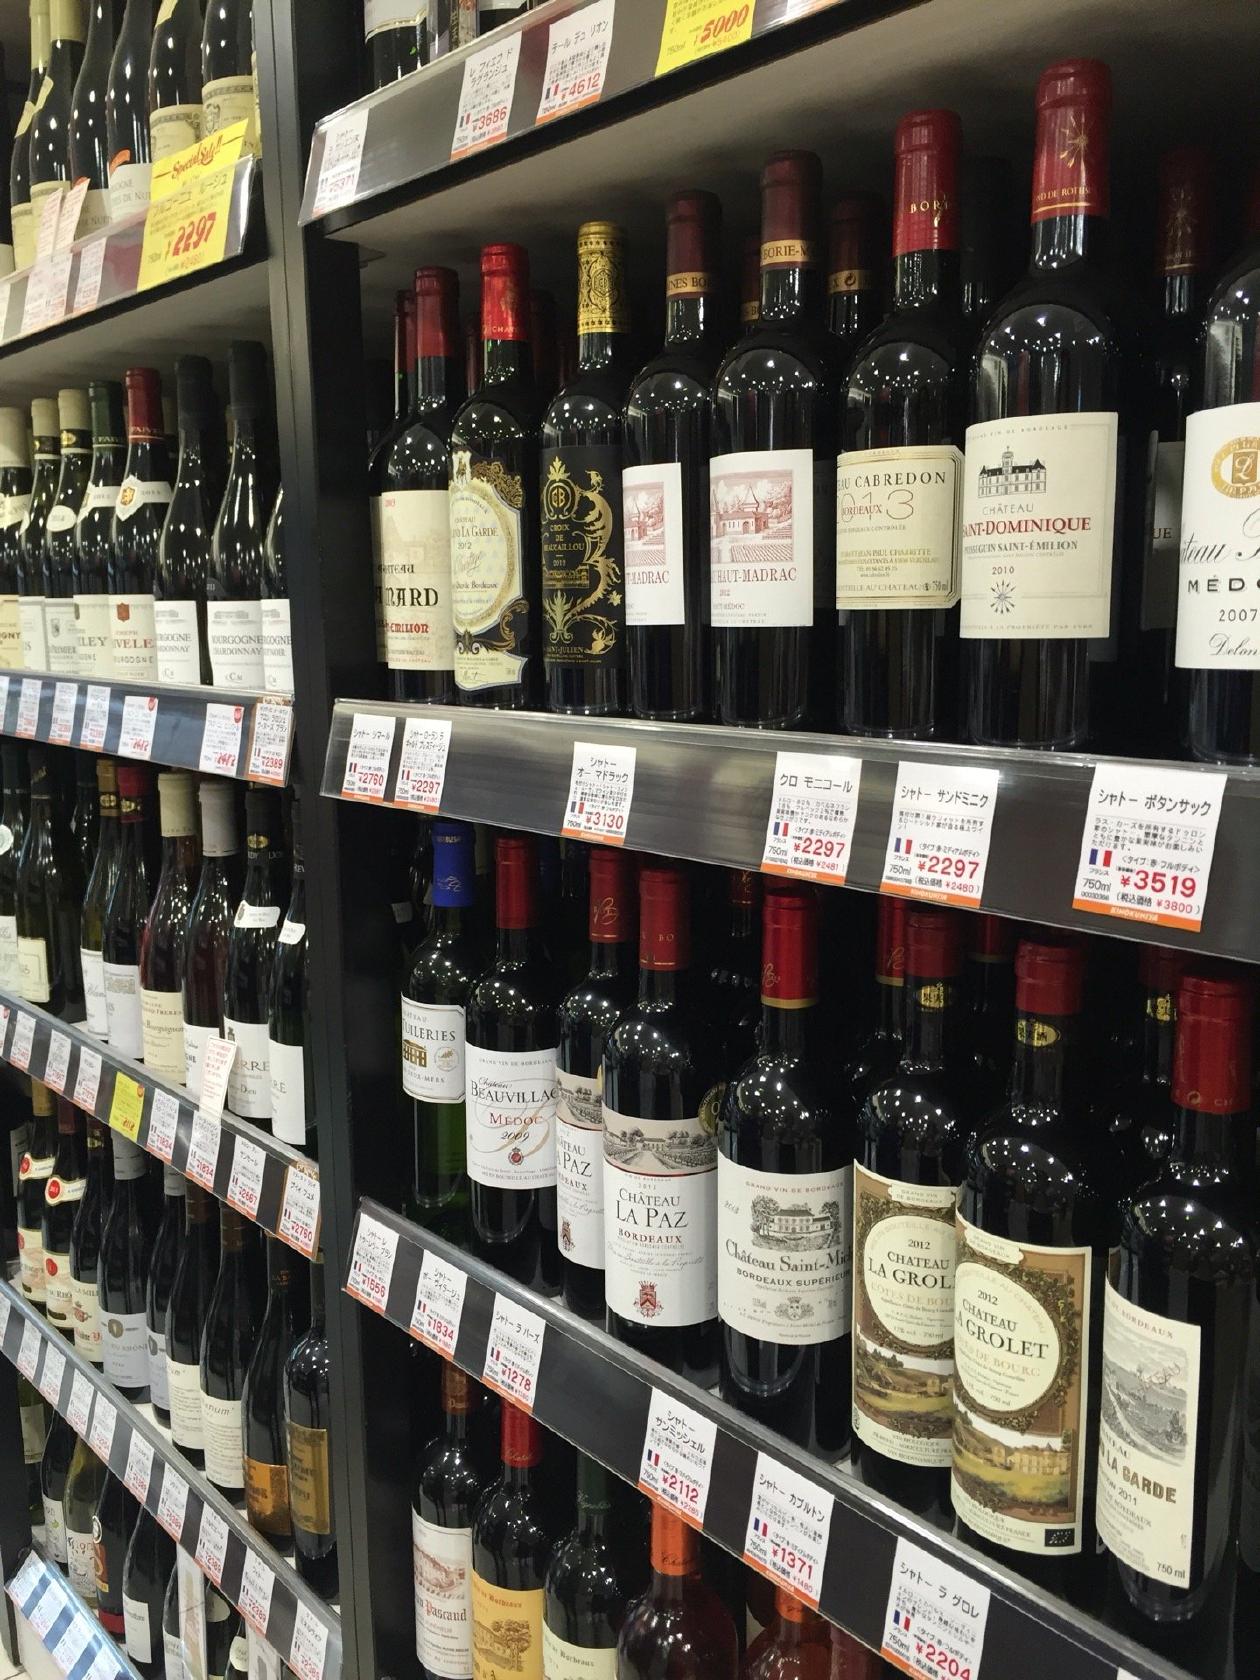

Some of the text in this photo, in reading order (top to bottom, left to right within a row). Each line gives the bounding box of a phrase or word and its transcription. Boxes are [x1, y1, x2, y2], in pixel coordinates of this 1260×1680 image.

[701, 4, 749, 43] 5000
[172, 211, 216, 257] 2297
[855, 471, 946, 488] CABREDON
[983, 503, 1034, 516] CHÂTEAU
[992, 566, 1015, 575] 2010
[1218, 608, 1258, 622] 2007
[590, 757, 617, 767] シャトー
[595, 770, 629, 783] マドラック
[780, 773, 853, 793] クロ モニコール
[412, 780, 440, 795] ¥2297
[900, 785, 989, 808] シャトー サンドミニク
[1098, 789, 1212, 817] シャトー ボタンサック
[586, 811, 624, 830] ¥3130
[793, 837, 845, 858] ¥2297
[889, 863, 912, 876] 750ml
[917, 856, 979, 880] ¥2297
[945, 880, 974, 893] ¥2480
[1082, 877, 1111, 892] 750ml
[1120, 869, 1197, 898] ¥3519
[1156, 899, 1193, 914] ¥3800
[563, 1152, 592, 1178] PAZ
[619, 1187, 680, 1206] CHÂTEAU
[616, 1200, 688, 1229] LA PAZ
[618, 1227, 682, 1243] BORDEAUX
[907, 1239, 931, 1249] 2012
[725, 1238, 775, 1271] Château
[887, 1250, 949, 1270] CHATEAU
[736, 1266, 792, 1288] BORDEAUX
[868, 1257, 887, 1279] LA
[977, 1289, 999, 1306] 2012
[496, 1311, 514, 1326] シャトー
[962, 1298, 1018, 1332] CHATEAU
[428, 1318, 454, 1341] ¥1834
[966, 1318, 1049, 1360] GROLET
[501, 1367, 532, 1392] ¥1278
[667, 1410, 696, 1432] シャトー
[655, 1416, 705, 1454] サンミッシェル
[1106, 1449, 1177, 1505] LA GARDE
[662, 1474, 699, 1505] ¥2112
[759, 1473, 786, 1495] シャトー
[789, 1493, 825, 1522] カブルトン
[1118, 1486, 1138, 1506] 2011
[771, 1546, 813, 1580] ¥1371
[1156, 1562, 1186, 1579] 750 ml
[900, 1562, 933, 1587] シャトー
[938, 1585, 947, 1598] ラ
[952, 1593, 979, 1618] グロレ
